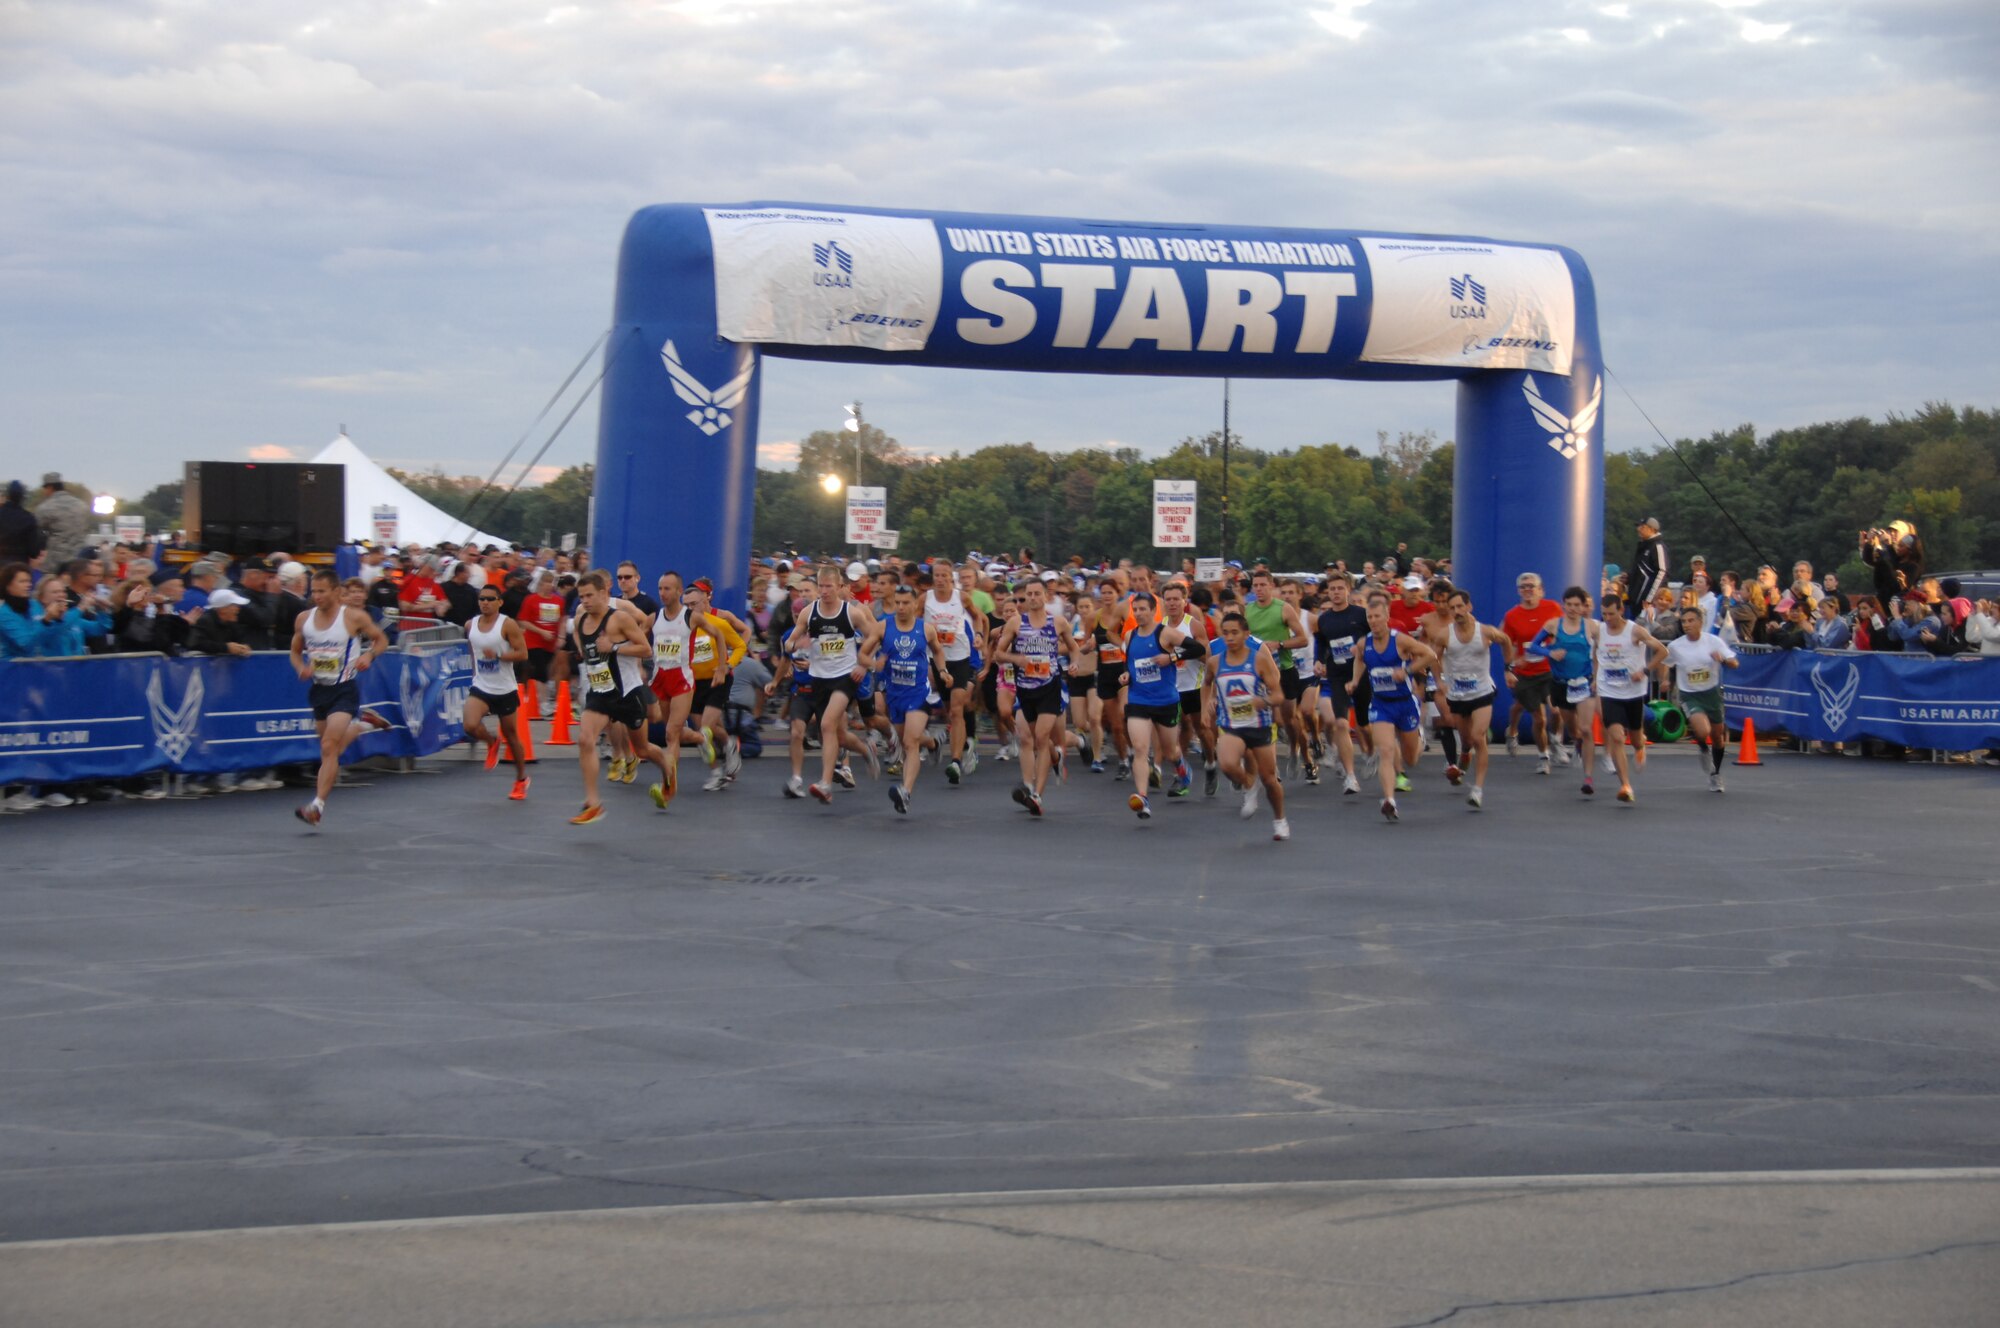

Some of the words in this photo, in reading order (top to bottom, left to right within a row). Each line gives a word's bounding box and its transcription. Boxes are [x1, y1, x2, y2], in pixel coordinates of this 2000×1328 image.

[945, 228, 1033, 255] UNITED
[1032, 232, 1118, 259] STATES
[1121, 236, 1160, 261] AIR
[1158, 238, 1233, 263] FORCE
[1235, 241, 1356, 267] MARATHON
[813, 272, 853, 289] USAA
[956, 259, 1358, 354] START
[1450, 305, 1486, 319] USAA
[850, 313, 925, 328] BOEING
[1488, 338, 1559, 351] BOEING
[1900, 708, 2000, 720] USAFMARAT
